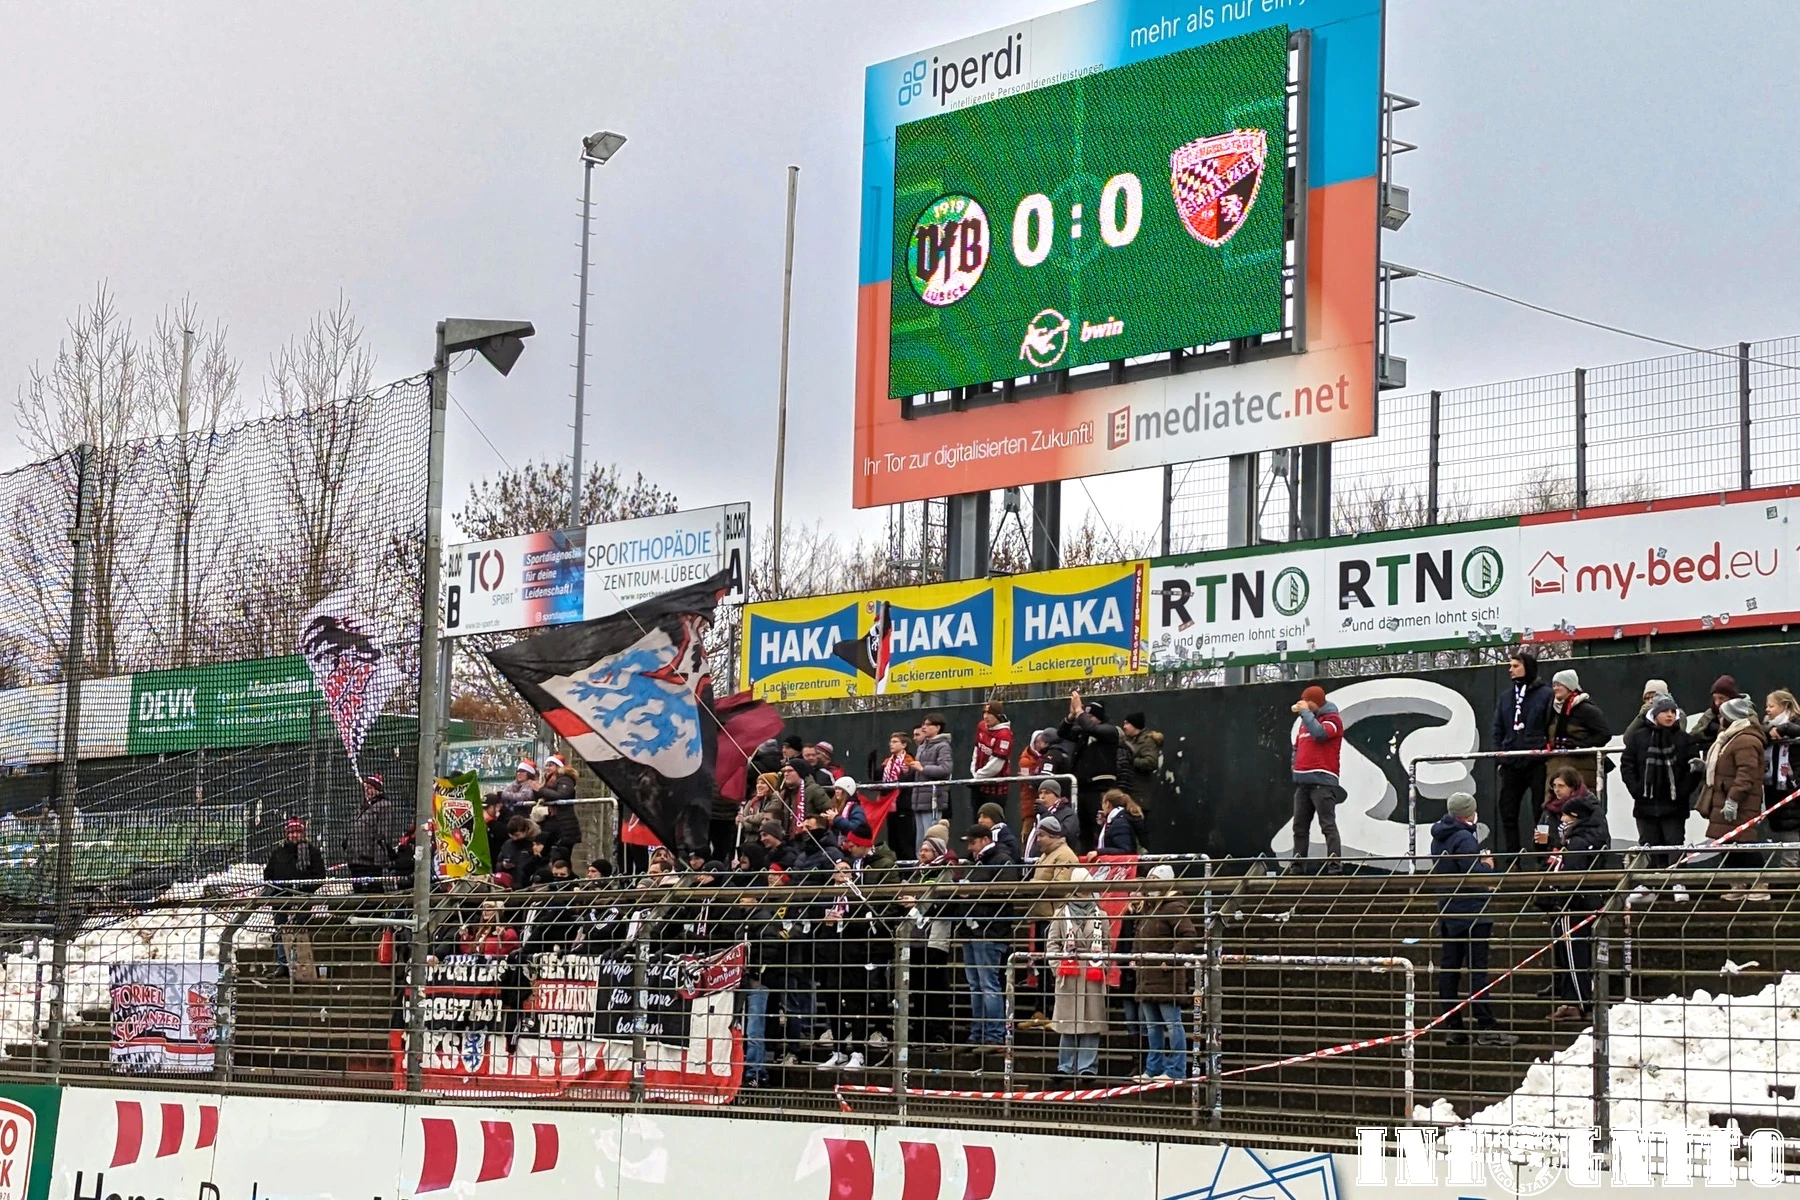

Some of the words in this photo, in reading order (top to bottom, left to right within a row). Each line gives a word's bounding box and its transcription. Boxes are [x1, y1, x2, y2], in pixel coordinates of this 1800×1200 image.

[1130, 16, 1181, 48] mehr
[1186, 6, 1214, 33] als
[932, 32, 1023, 107] iperdi
[950, 90, 995, 110] intelligente
[997, 63, 1104, 97] Personaldienstleistungen
[934, 199, 965, 218] 1919
[916, 217, 982, 284] VfB
[1080, 316, 1125, 342] bwin
[1135, 374, 1351, 443] mediatec.net
[863, 457, 881, 477] Ihr
[884, 453, 906, 473] Tor
[908, 453, 931, 470] zur
[934, 436, 1028, 469] digitalisierten
[1030, 421, 1094, 452] Zukunft!
[726, 511, 746, 541] BLOCK
[586, 529, 712, 569] SPORTHOPÄDIE
[467, 549, 505, 594] TO
[525, 571, 535, 582] für
[537, 568, 558, 580] deine
[727, 547, 744, 596] A
[1338, 549, 1453, 611] RTN
[1576, 541, 1779, 600] my-bed.eu
[446, 585, 461, 629] B
[491, 592, 514, 606] SPORT
[1024, 596, 1125, 642] HAKA
[1161, 570, 1265, 628] RTN
[1435, 610, 1468, 625] lohnt
[1471, 606, 1500, 622] sich!
[760, 625, 843, 666] HAKA
[1174, 634, 1194, 648] und
[1248, 627, 1276, 641] lohnt
[1279, 624, 1306, 638] sich!
[763, 678, 841, 693] Lackierzentrum
[890, 667, 975, 684] Lackierzentrum
[139, 686, 198, 721] DEVK
[539, 953, 600, 980] SEKTION
[110, 983, 165, 1014] TORKEL
[538, 983, 597, 1012] STADION
[608, 989, 632, 1011] für
[115, 1008, 182, 1048] SCHANZER
[538, 1013, 595, 1041] VERBOT
